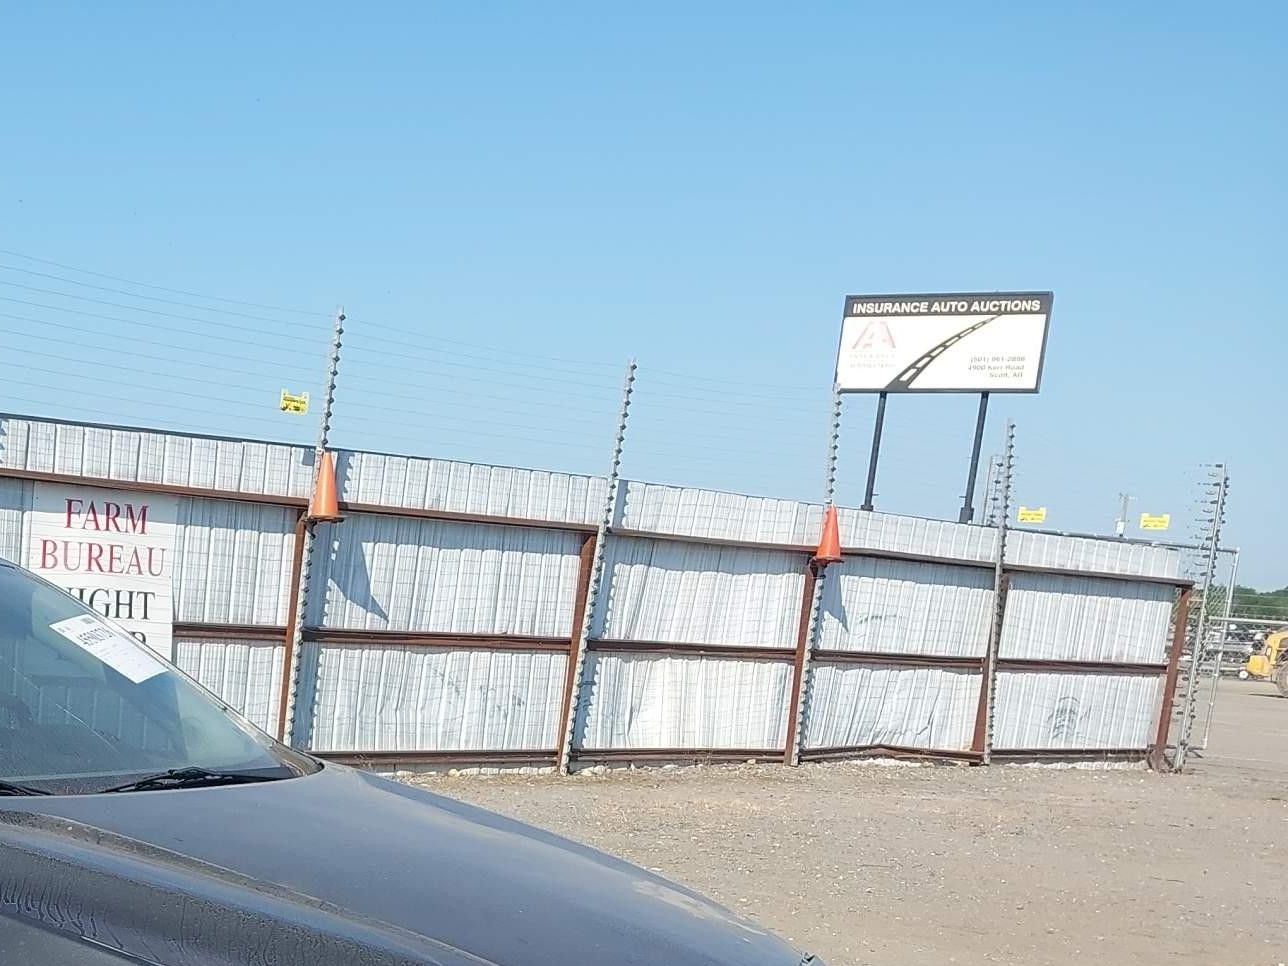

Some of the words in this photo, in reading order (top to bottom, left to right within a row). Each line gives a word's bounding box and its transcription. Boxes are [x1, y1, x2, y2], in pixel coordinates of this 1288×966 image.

[853, 302, 928, 314] INSURANCE
[931, 302, 967, 312] AUTO
[970, 300, 1040, 312] AUCTIONS
[64, 498, 149, 535] FARM
[39, 538, 168, 577] BUREAU
[66, 587, 155, 621] IGHT
